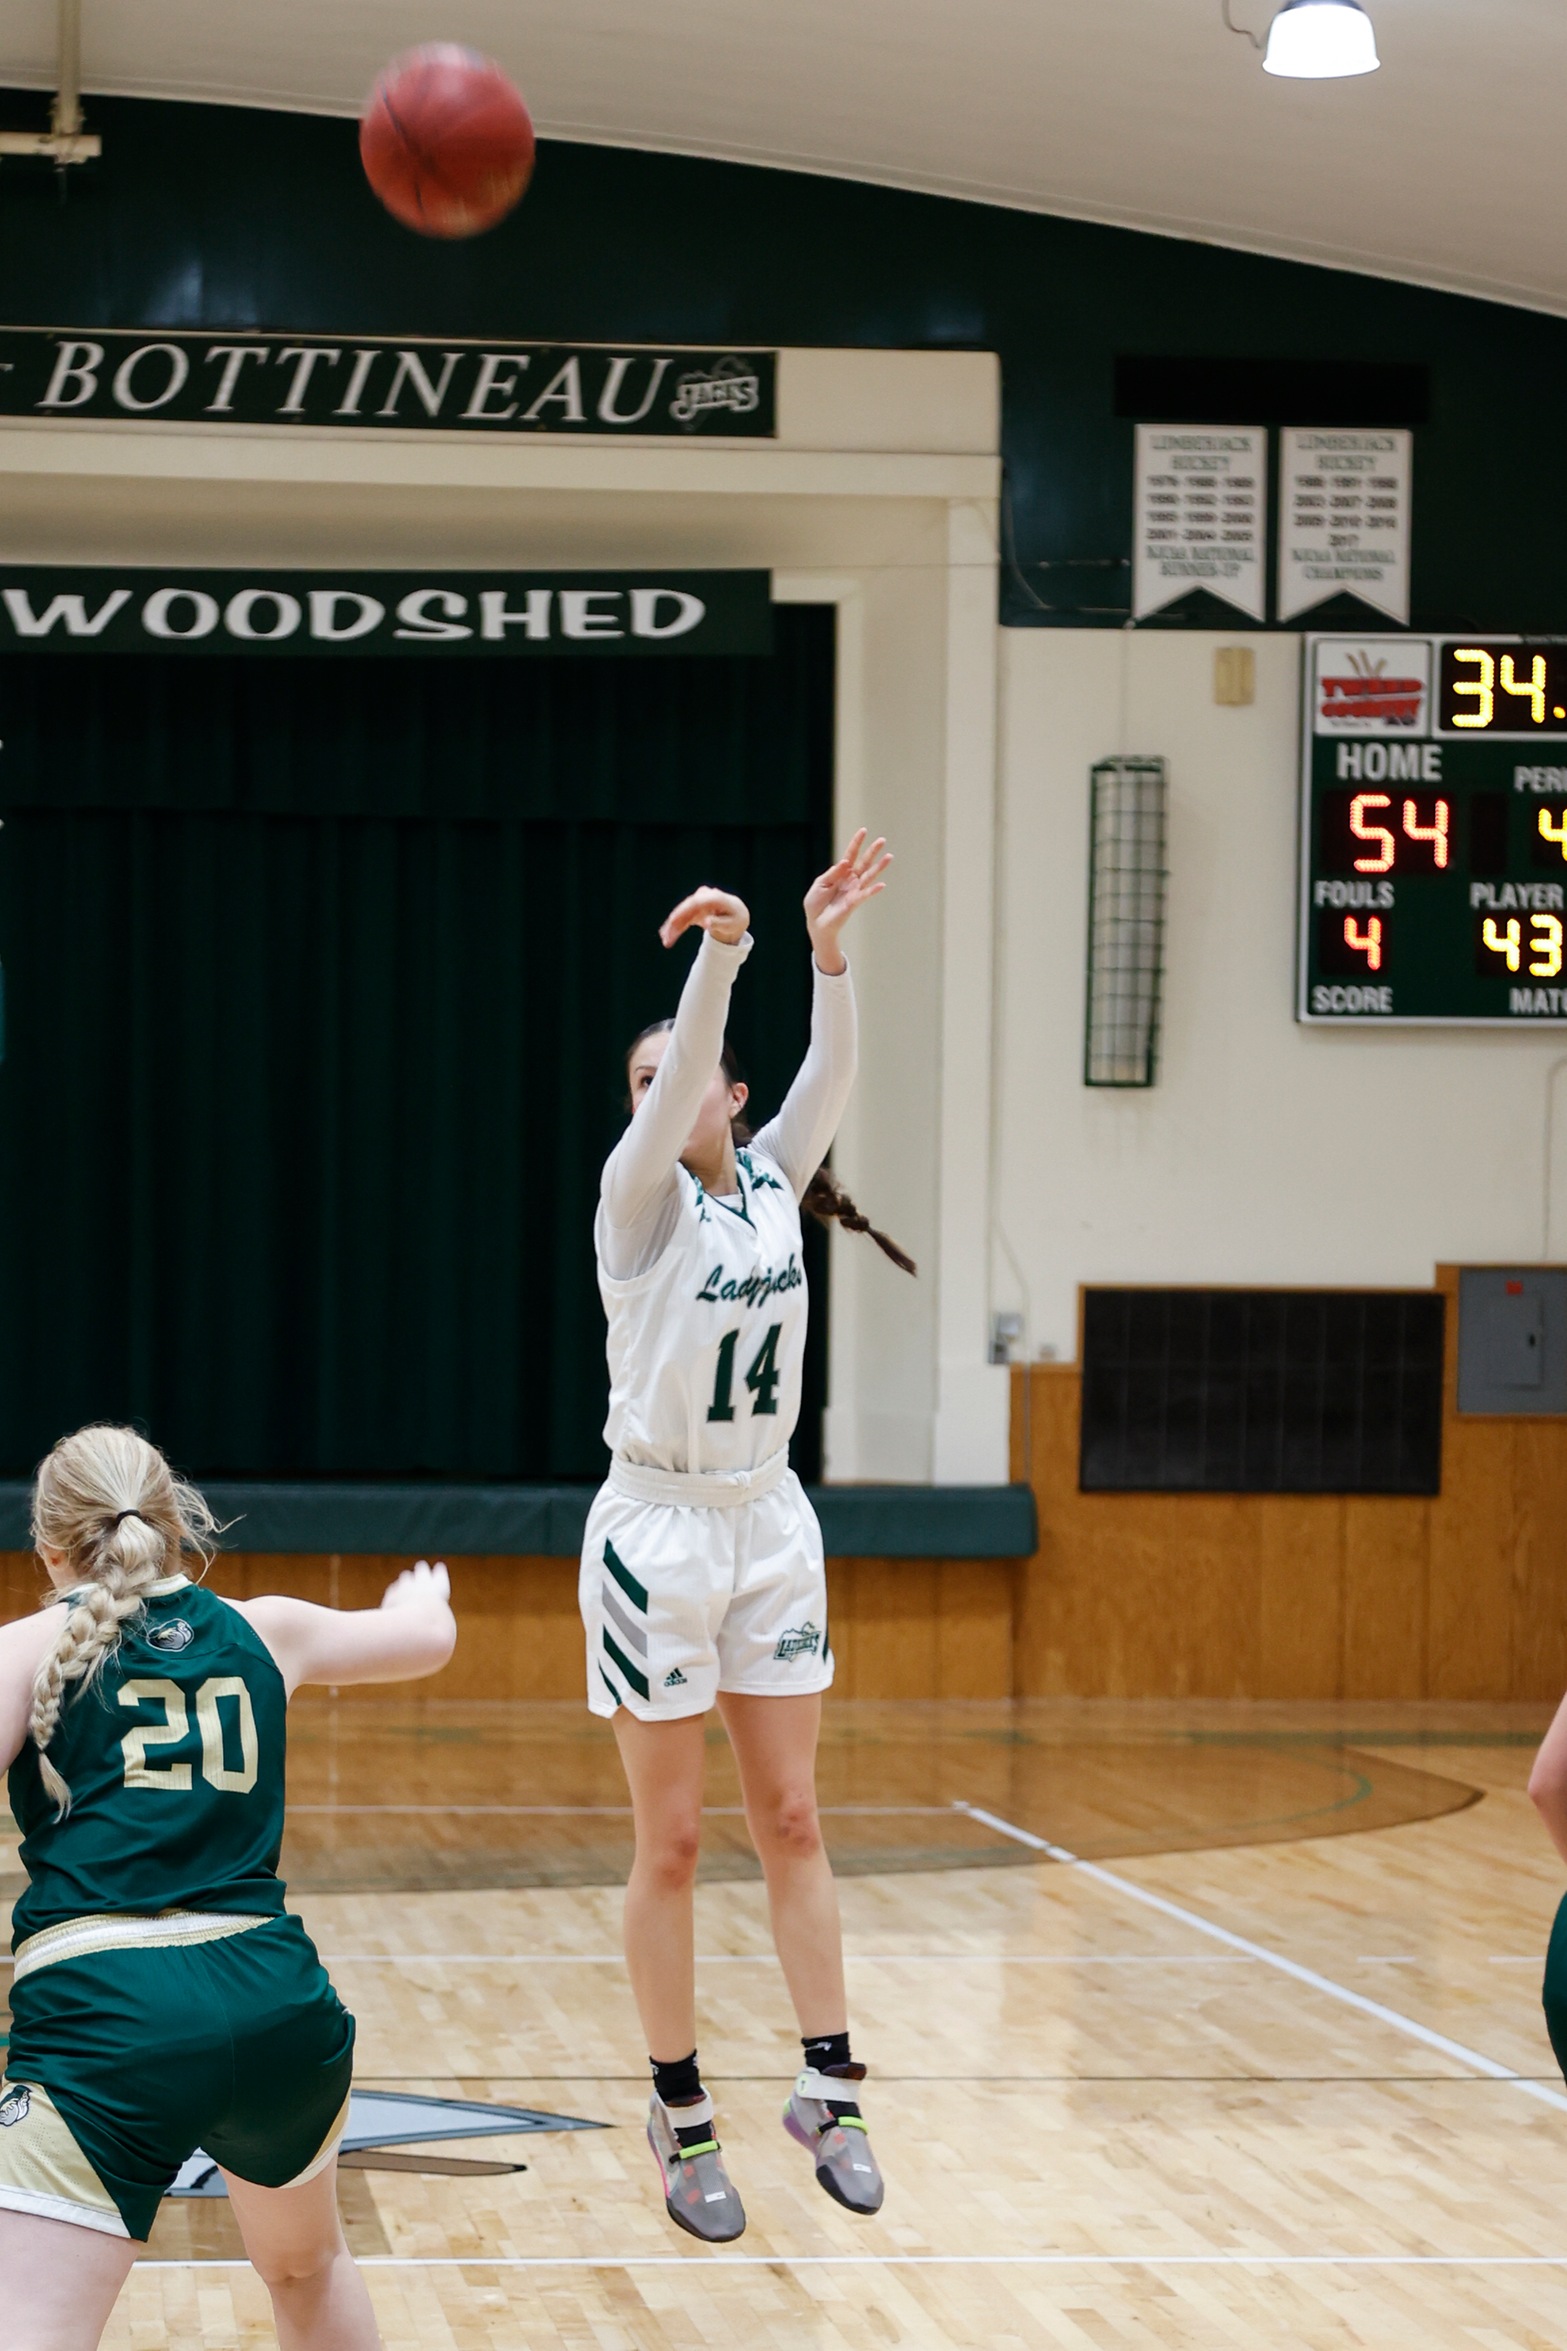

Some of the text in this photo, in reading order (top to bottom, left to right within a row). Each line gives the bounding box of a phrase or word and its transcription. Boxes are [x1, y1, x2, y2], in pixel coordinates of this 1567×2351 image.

[36, 340, 677, 423] BOTTINEAU
[2, 587, 706, 642] WOODSHED
[1336, 743, 1443, 782] HOME
[1350, 793, 1449, 873] 54
[1538, 808, 1567, 862] 4
[1313, 880, 1396, 910] FOULS
[1469, 881, 1565, 911] PLAYER
[1343, 915, 1382, 971] 4
[1482, 913, 1563, 977] 43
[1312, 985, 1395, 1015] SCORE
[706, 1322, 782, 1423] 14
[117, 1676, 259, 1794] 20
